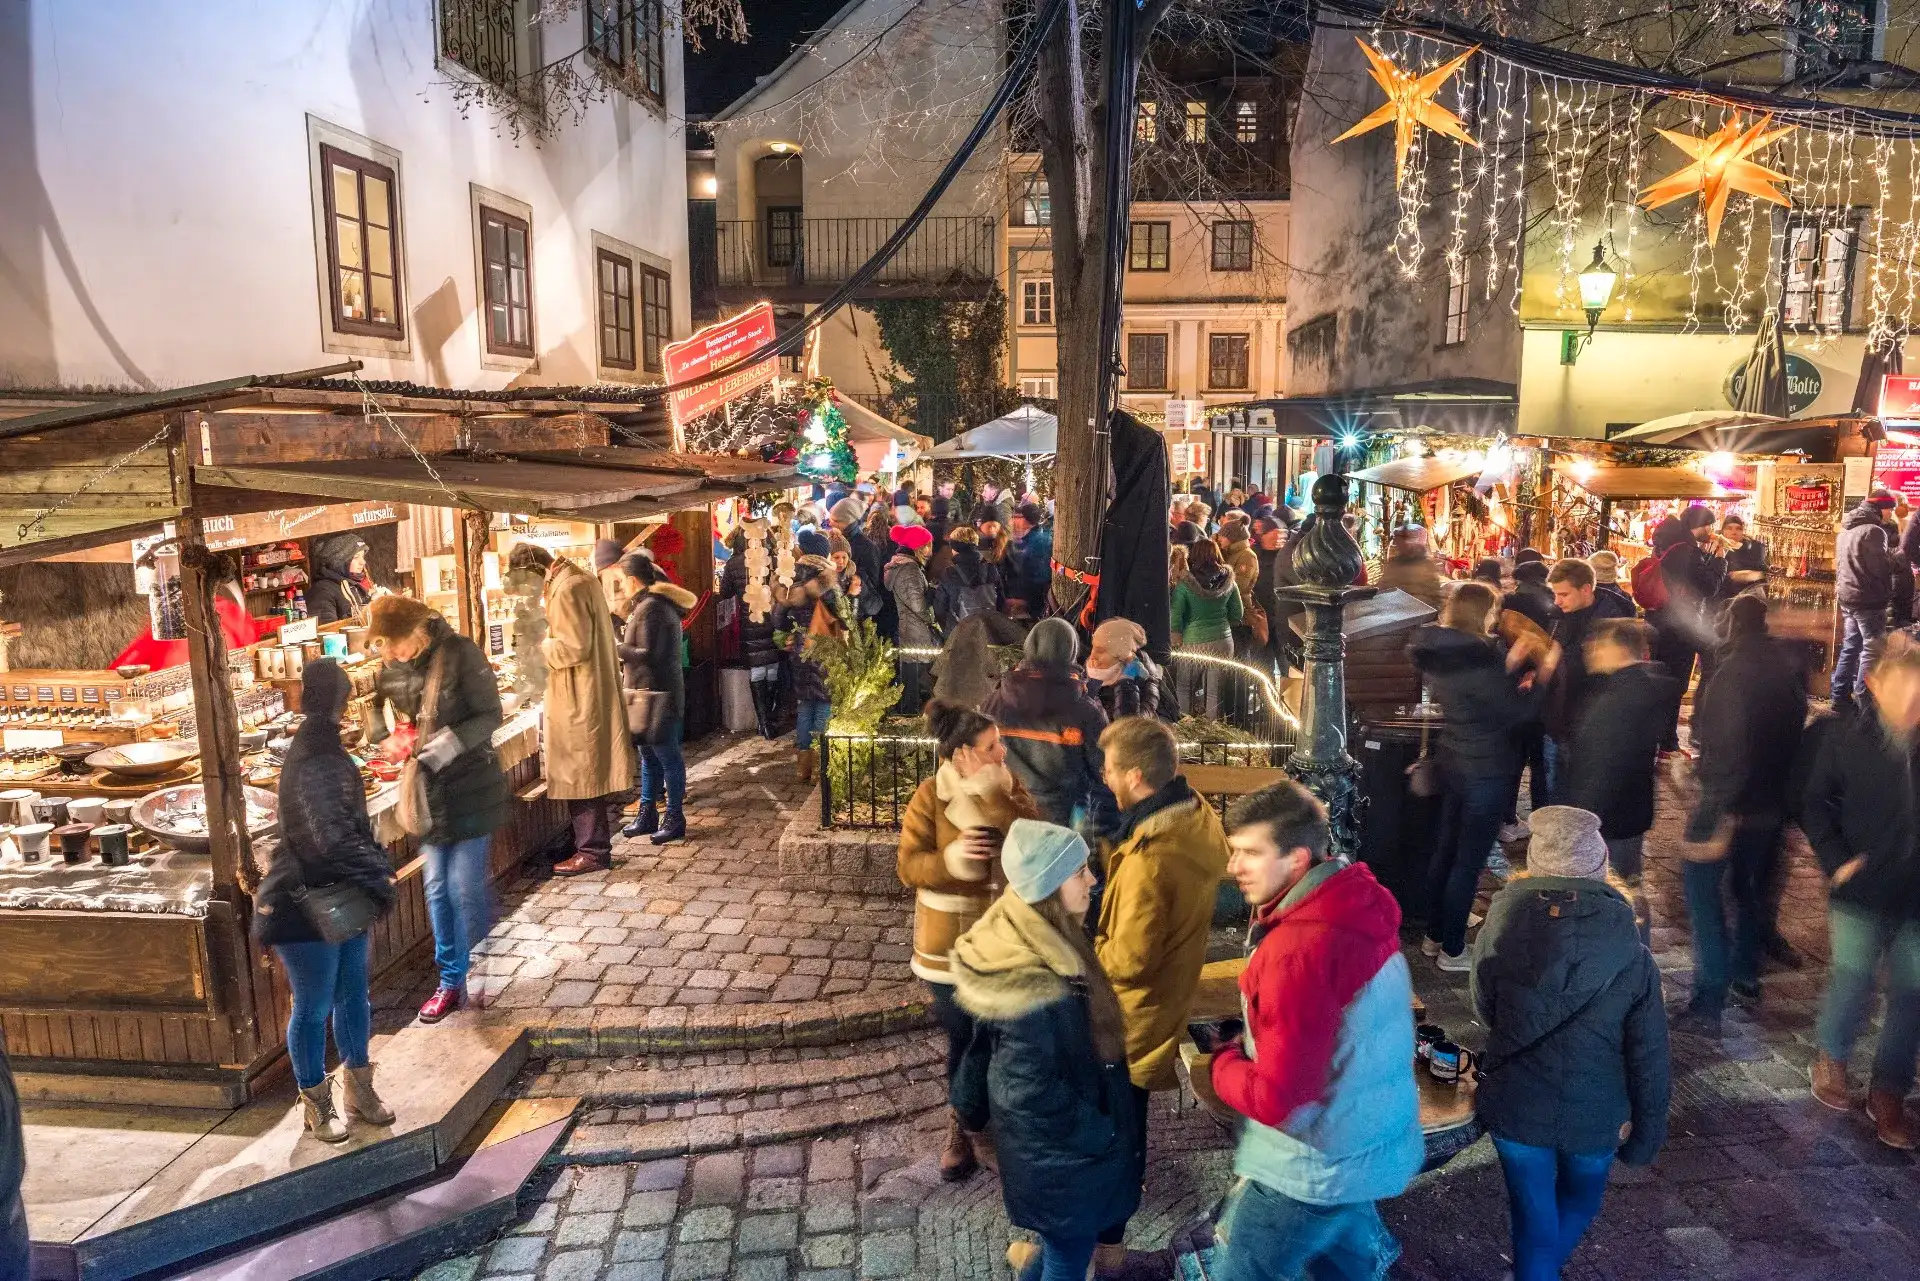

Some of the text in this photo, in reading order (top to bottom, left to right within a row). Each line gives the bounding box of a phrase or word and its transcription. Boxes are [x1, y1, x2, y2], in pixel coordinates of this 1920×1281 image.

[706, 328, 738, 349] Restaurant
[690, 353, 708, 366] ebener
[709, 347, 722, 357] Erde
[722, 341, 732, 351] und
[732, 335, 747, 346] erster
[710, 351, 741, 371] Heisser
[1786, 376, 1820, 395] Bolte
[352, 503, 397, 524] natursalz
[203, 515, 234, 533] auch
[511, 523, 538, 535] salz
[527, 531, 569, 539] spezialitäten
